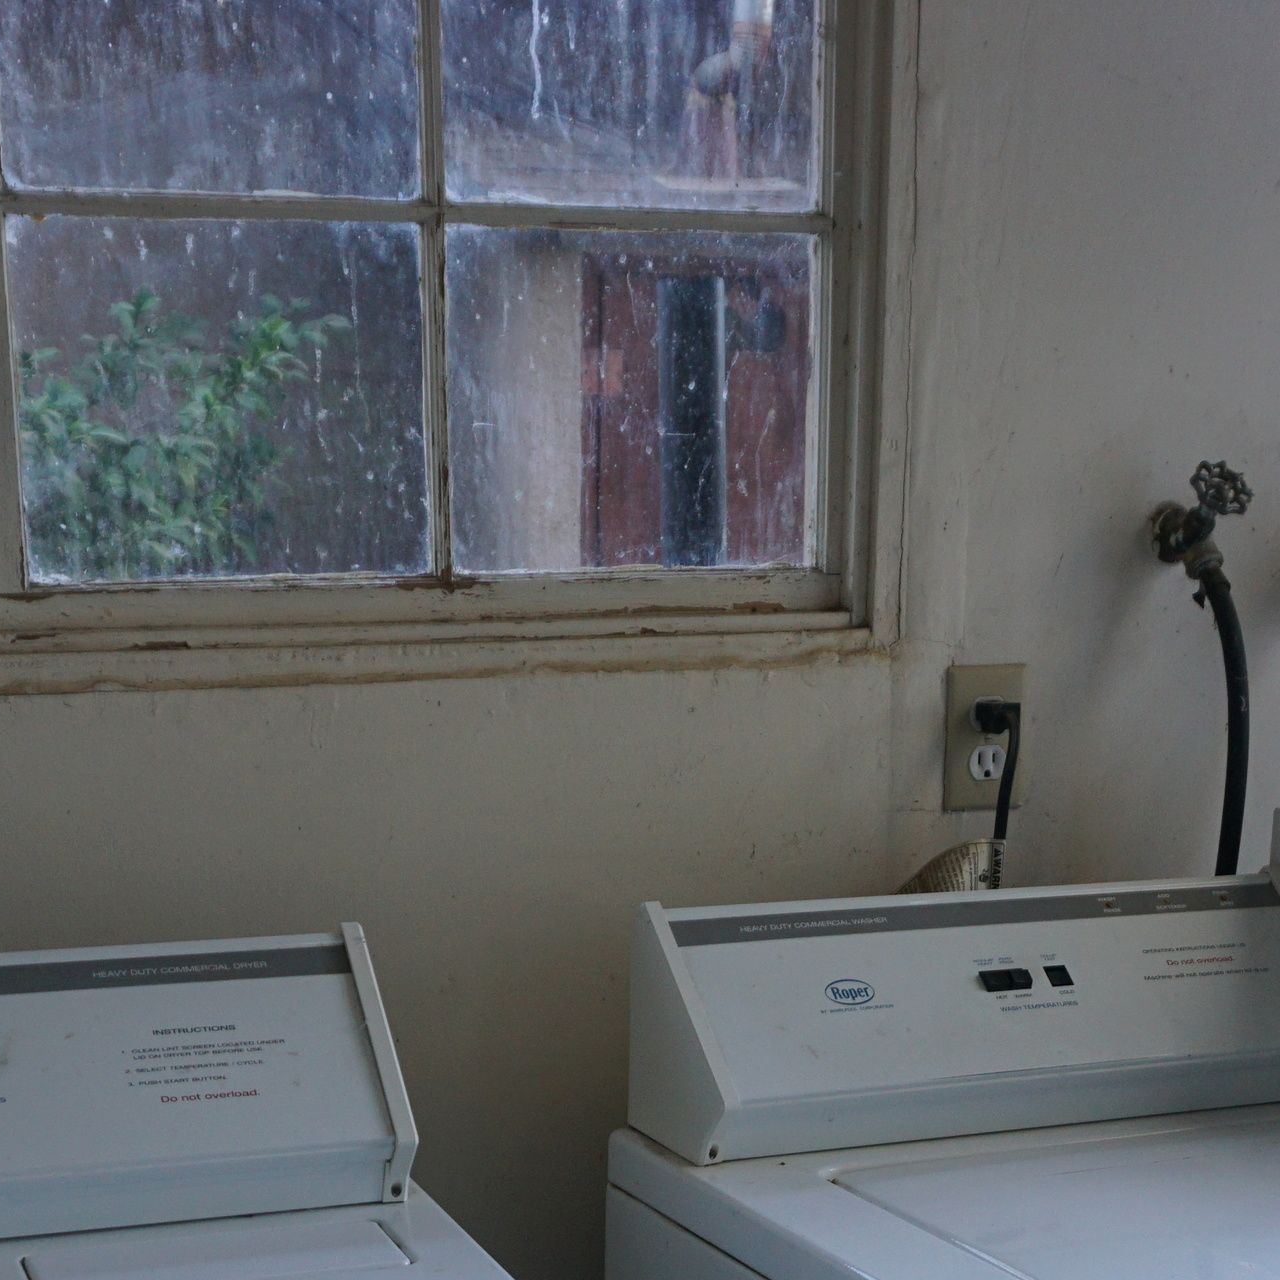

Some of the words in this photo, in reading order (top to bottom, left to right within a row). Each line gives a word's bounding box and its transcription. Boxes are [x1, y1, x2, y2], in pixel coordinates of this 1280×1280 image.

[739, 924, 768, 933] HEAVY
[770, 922, 792, 931] DUTY
[793, 918, 851, 929] COMMERCIAL
[852, 916, 888, 926] WASHER
[92, 970, 128, 979] HEAVY
[130, 967, 158, 976] DUTY
[160, 963, 231, 975] COMMERCIAL
[232, 960, 268, 970] DRYER
[830, 985, 870, 1001] Roper
[152, 1024, 237, 1036] INSTRUCTIONS
[217, 1040, 255, 1048] LOCATED
[256, 1038, 285, 1046] UNDER
[169, 1062, 229, 1071] TEMPERATURE
[160, 1095, 178, 1103] Do
[181, 1093, 202, 1102] not
[204, 1088, 261, 1100] overload.
